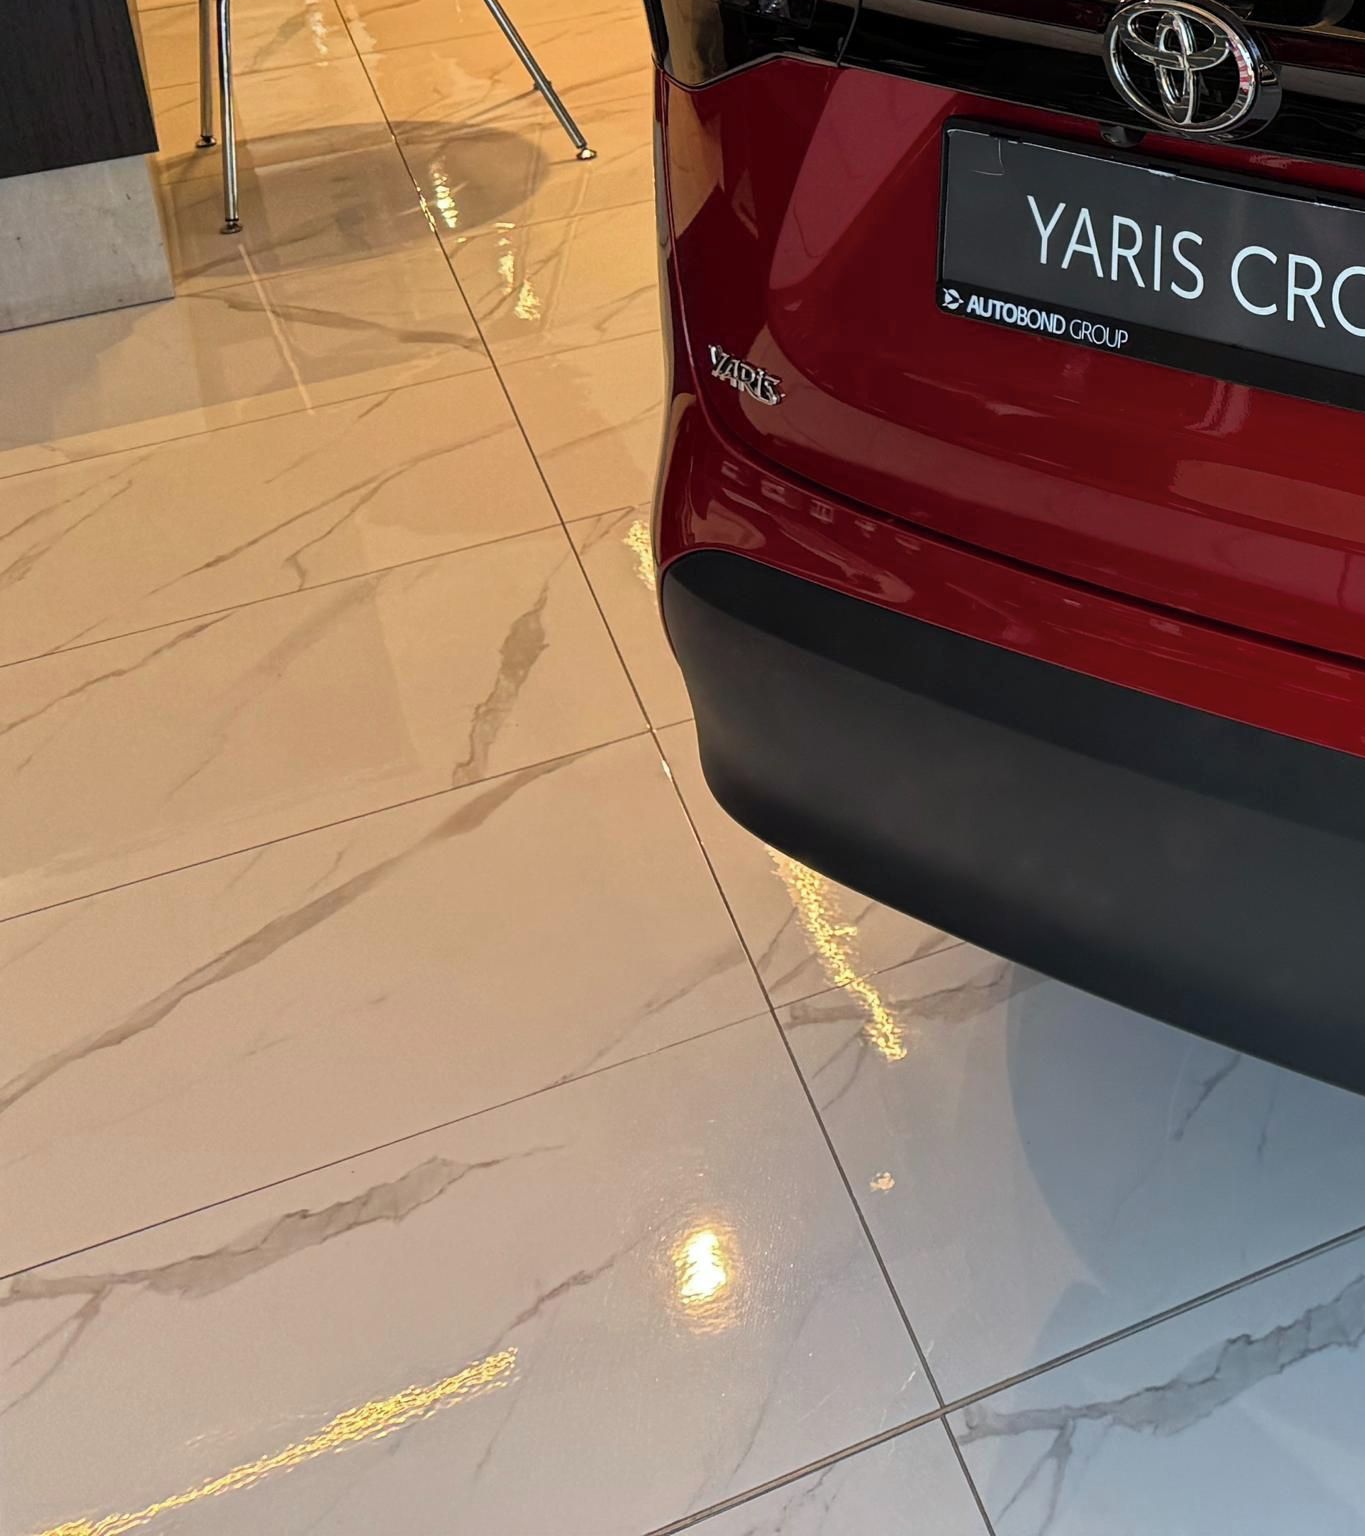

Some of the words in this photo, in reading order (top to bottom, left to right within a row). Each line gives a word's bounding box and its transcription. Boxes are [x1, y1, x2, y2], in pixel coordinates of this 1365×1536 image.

[1026, 194, 1205, 300] YARIS
[966, 293, 1066, 335] AUTOBOND
[1069, 318, 1129, 349] GROUP
[708, 344, 786, 406] YARIS
